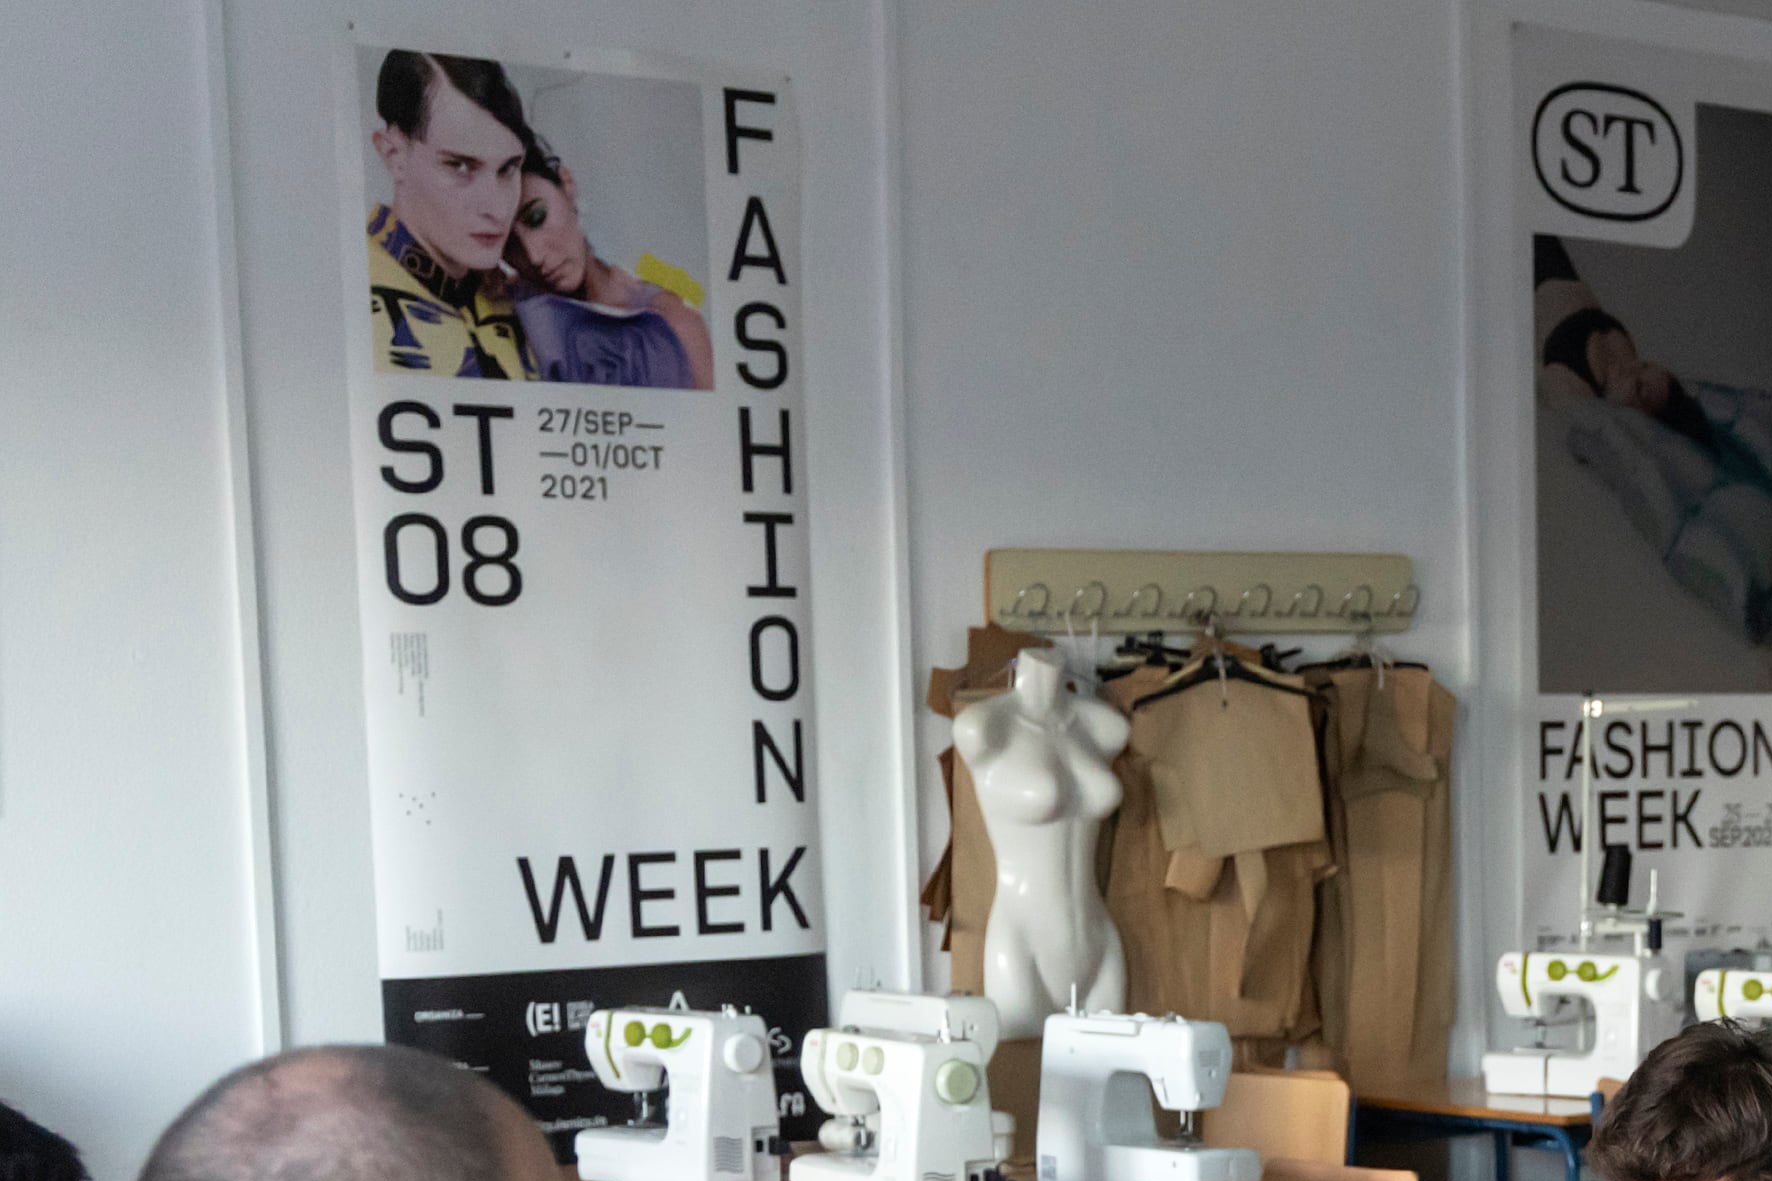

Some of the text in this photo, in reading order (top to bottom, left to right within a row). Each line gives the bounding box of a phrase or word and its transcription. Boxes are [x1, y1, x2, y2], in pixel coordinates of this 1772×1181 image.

[1562, 109, 1655, 194] ST
[376, 400, 515, 496] ST
[540, 473, 608, 500] 2021
[722, 86, 807, 804] FASHION
[383, 511, 523, 607] 08
[1538, 788, 1704, 855] WEEK
[515, 845, 811, 945] WEEK
